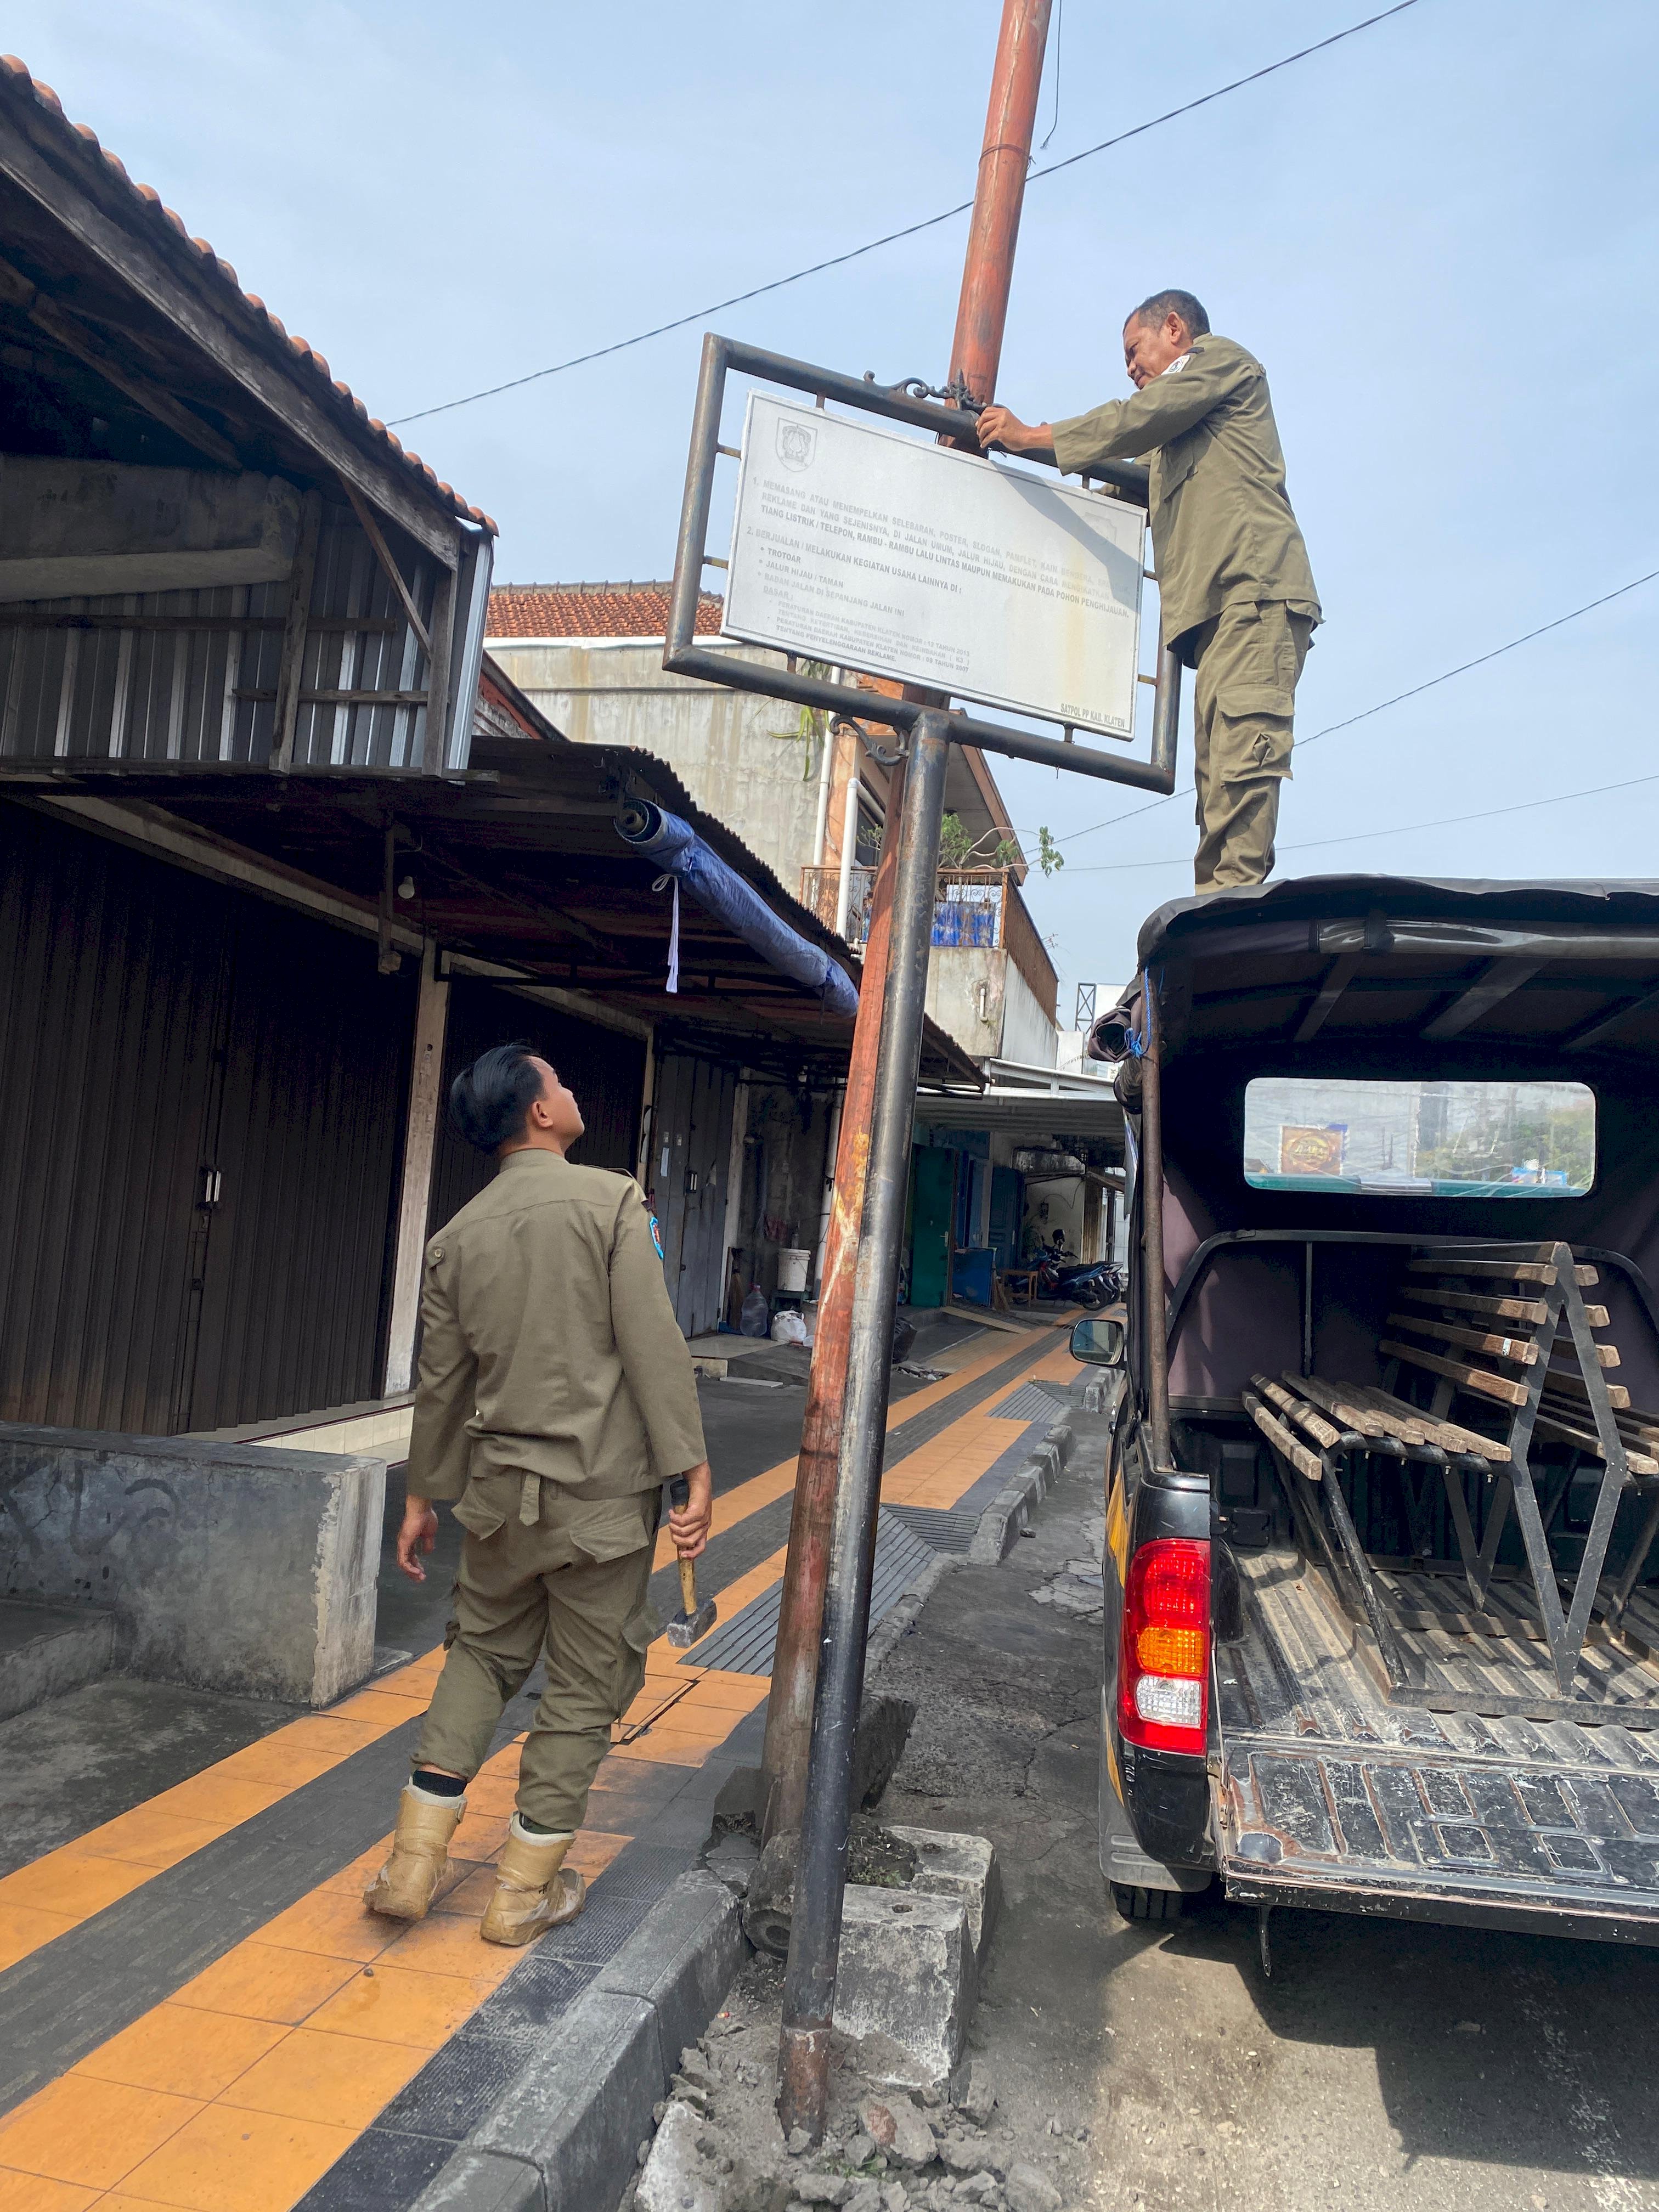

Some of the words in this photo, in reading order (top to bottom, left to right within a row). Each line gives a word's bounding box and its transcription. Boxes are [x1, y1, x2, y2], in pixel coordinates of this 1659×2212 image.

[753, 476, 759, 485] 1.
[763, 479, 805, 499] MEMASANG
[810, 493, 828, 505] ATAU
[832, 500, 887, 522] MENEMPELKAN
[891, 517, 935, 537] SELEBARAN,
[939, 531, 968, 547] POSTER,
[972, 540, 1002, 557] SLOGAN,
[1041, 561, 1057, 573] KAIN
[761, 492, 797, 509] REKLAME
[800, 503, 816, 514] DAN
[820, 509, 839, 521] YANG
[843, 515, 889, 537] SEJENISNYA,
[893, 529, 900, 538] DI
[905, 533, 927, 546] JALAN
[931, 540, 954, 556] UMUM,
[958, 549, 979, 562] JALUR
[983, 556, 1005, 570] HIJAU,
[1009, 564, 1036, 579] DENGAN
[1040, 573, 1058, 585] CARA
[747, 526, 753, 535] 2.
[755, 528, 799, 548] BERJUALAN
[805, 543, 851, 563] MELAKUKAN
[854, 556, 890, 574] KEGIATAN
[891, 567, 916, 581] USAHA
[918, 574, 948, 590] LAINNYA
[950, 584, 957, 592] DI
[760, 504, 783, 518] TIANG
[786, 512, 814, 527] LISTRIK
[820, 521, 855, 540] TELEPON,
[857, 532, 882, 546] RAMBU
[889, 540, 913, 555] RAMBU
[916, 549, 933, 561] LALU
[935, 554, 959, 568] LINTAS
[961, 562, 990, 577] MAUPUN
[992, 571, 1035, 591] MEMAKUKAN
[1037, 585, 1054, 596] PADA
[1056, 590, 1079, 604] POHON
[1081, 597, 1128, 618] PENGHIJAUAN.
[766, 560, 789, 573] JALUR
[791, 567, 812, 579] HIJAU
[819, 575, 843, 588] TAMAN
[767, 548, 800, 563] TROTOAR
[764, 573, 789, 586] BADAN
[791, 580, 814, 592] JALAN
[816, 587, 823, 596] DI
[825, 589, 868, 608] SEPANJANG
[870, 601, 893, 614] JALAN
[895, 608, 904, 617] INI
[776, 625, 804, 637] TENTANG
[806, 632, 865, 654] PENYELENGGARAAN
[867, 649, 896, 662] REKLAME.
[776, 616, 811, 631] PERATURAN
[814, 627, 837, 638] DAERAH
[839, 633, 874, 647] KABUPATEN
[876, 643, 898, 654] KLATEN
[900, 650, 921, 660] NOMOR
[934, 659, 953, 669] TAHUN
[956, 664, 968, 673] 2007
[777, 608, 806, 622] TENTANG
[896, 640, 907, 648] DAN
[912, 644, 945, 659] KEINDAHAN
[778, 600, 814, 615] PERATURAN
[815, 610, 839, 622] DAERAH
[842, 617, 875, 631] KABUPATEN
[878, 627, 900, 638] KLATEN
[901, 634, 922, 644] NOMOR
[935, 642, 955, 653] TAHUN
[956, 648, 969, 657] 2013
[1060, 702, 1081, 717] SATPOL
[1082, 708, 1089, 719] PP
[1104, 714, 1125, 728] KLATEN
